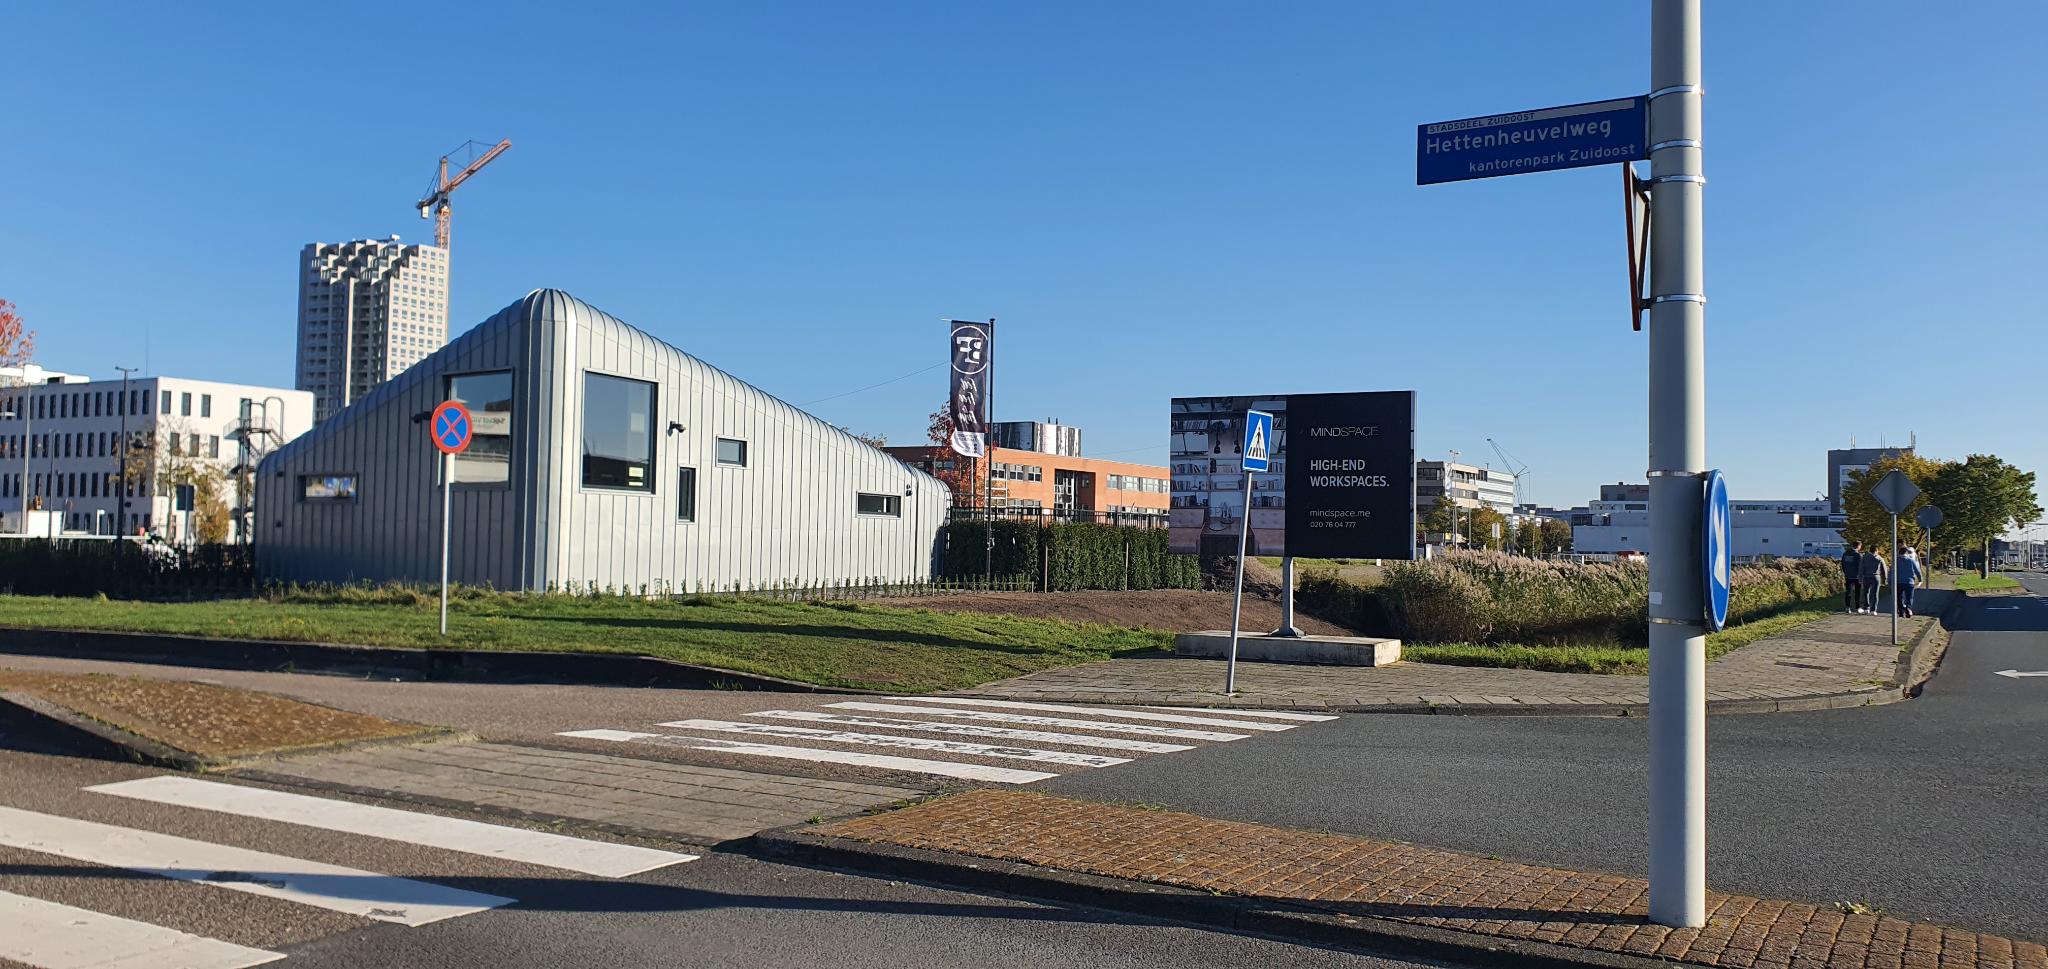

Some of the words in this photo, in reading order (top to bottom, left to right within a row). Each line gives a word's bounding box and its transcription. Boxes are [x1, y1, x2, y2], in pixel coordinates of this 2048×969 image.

[1428, 119, 1485, 133] STADSDEEL
[1487, 112, 1535, 126] ZUIDOOST
[1426, 119, 1611, 154] Hettenheuvelweg
[1469, 152, 1565, 172] kantorenpark
[1569, 143, 1636, 161] Zuidoost
[1310, 426, 1380, 437] MINDSPACE
[1310, 459, 1366, 471] HIGH-END
[1310, 475, 1390, 487] WORKSPACES.
[1309, 508, 1371, 519] mindspace.me
